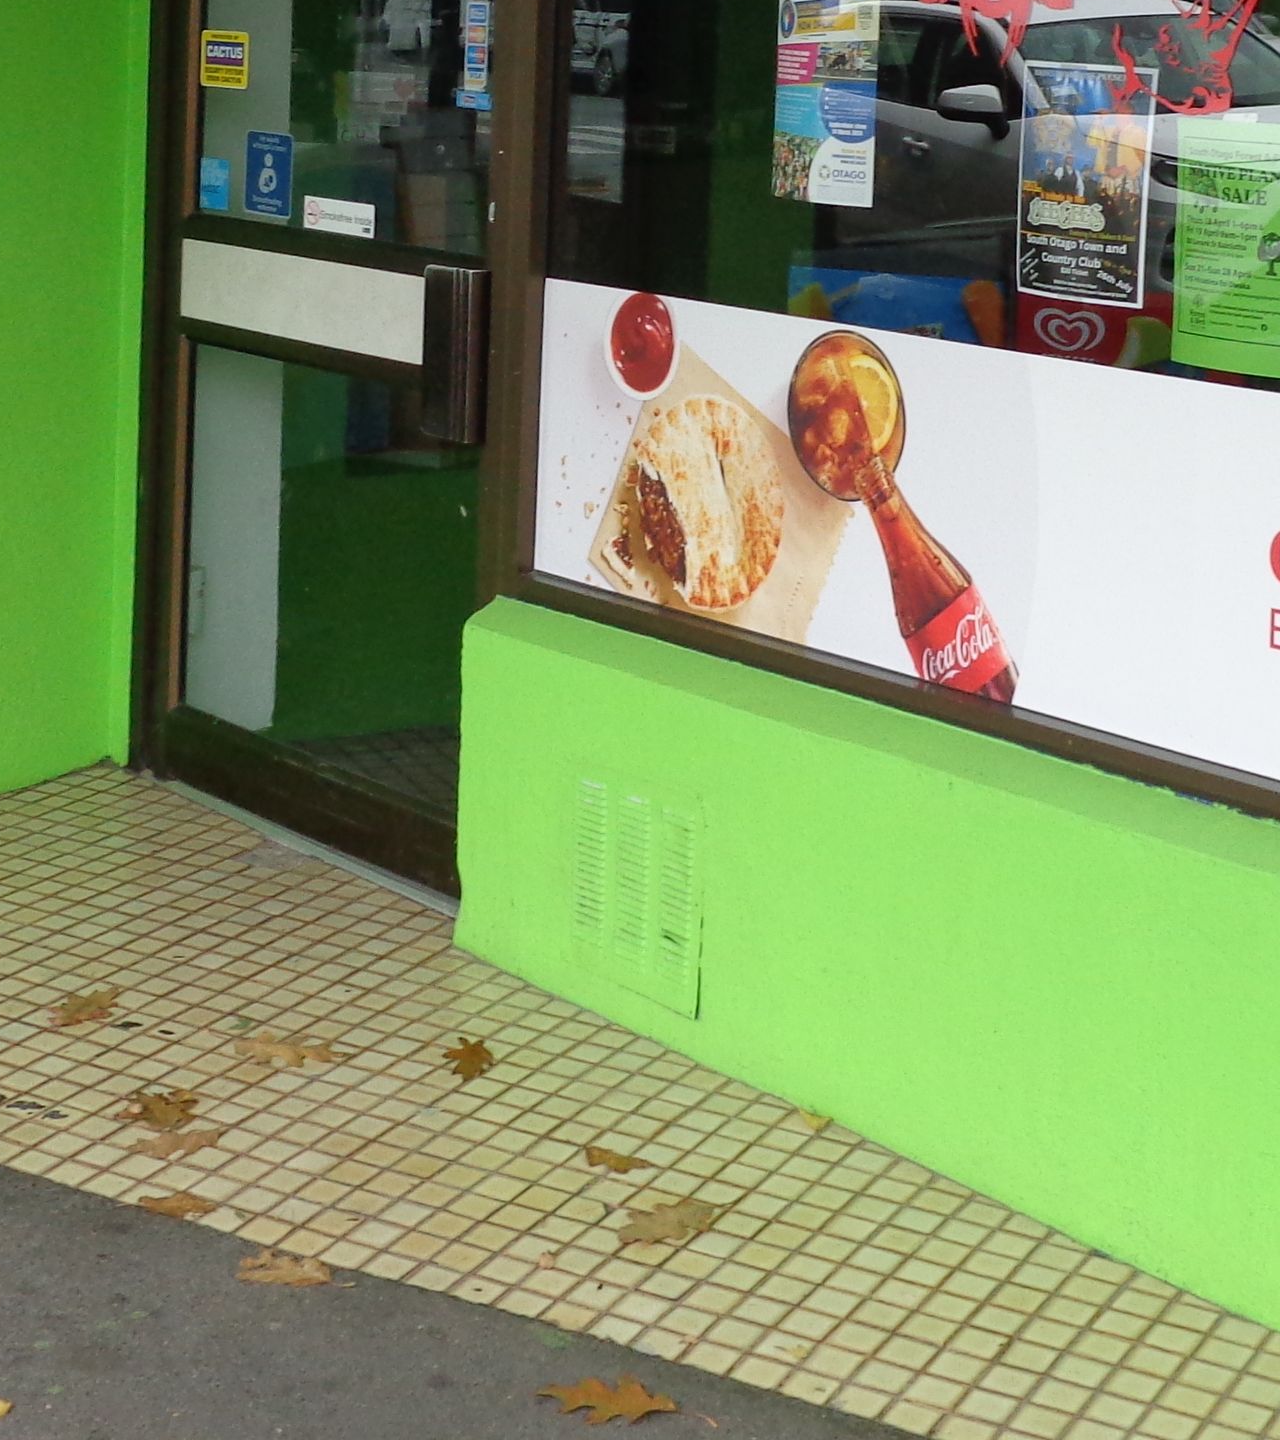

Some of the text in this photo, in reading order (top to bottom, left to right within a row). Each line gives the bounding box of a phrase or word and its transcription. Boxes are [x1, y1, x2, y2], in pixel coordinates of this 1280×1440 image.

[207, 45, 243, 59] CACTUS
[832, 169, 866, 180] OTAGO
[1222, 187, 1268, 206] SALE
[1027, 233, 1127, 254] South Otago Town and
[1041, 252, 1077, 267] Country
[1078, 257, 1101, 268] Club
[922, 605, 994, 682] Coca-Cola
